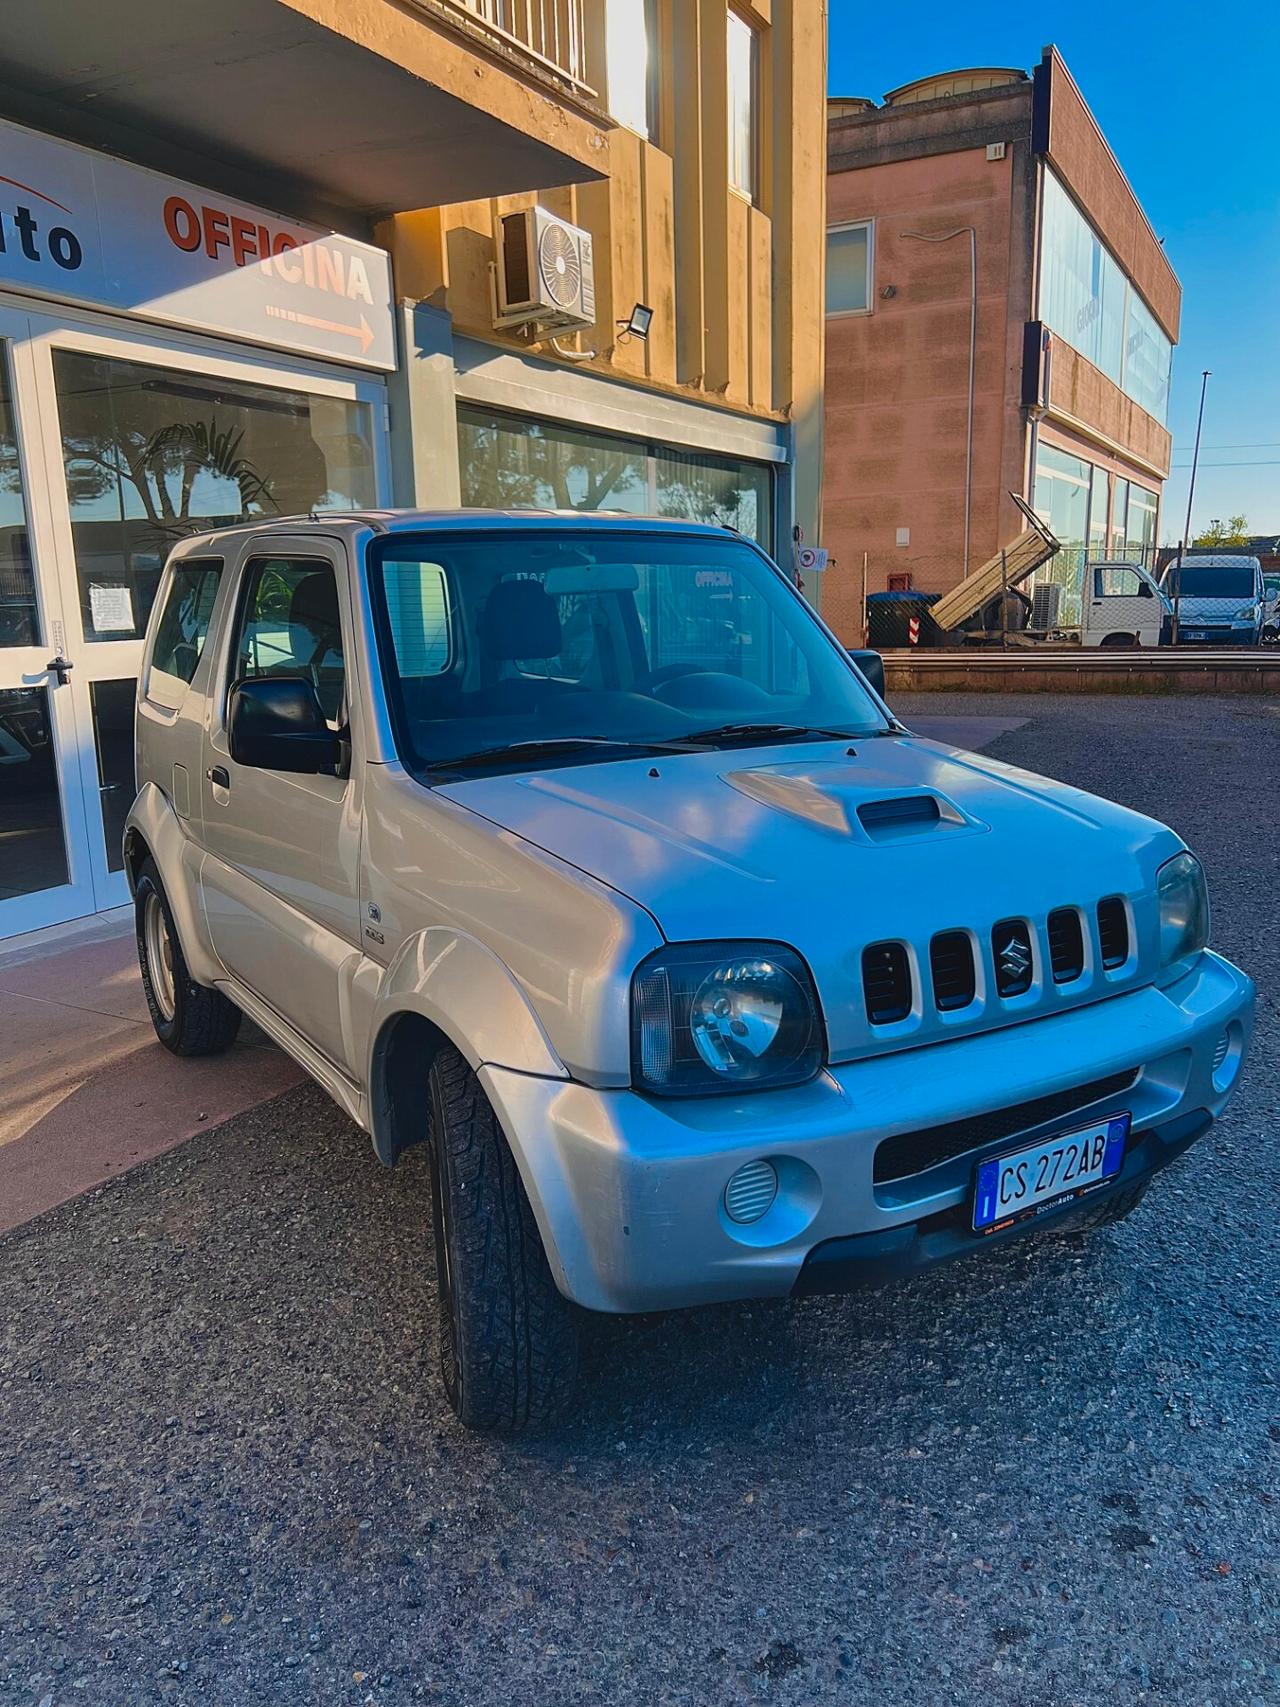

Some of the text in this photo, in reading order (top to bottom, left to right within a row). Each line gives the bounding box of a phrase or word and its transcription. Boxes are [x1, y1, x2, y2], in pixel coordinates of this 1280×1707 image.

[0, 204, 84, 271] to
[162, 195, 374, 305] OFFICINA
[1000, 1135, 1105, 1204] CS 272AB
